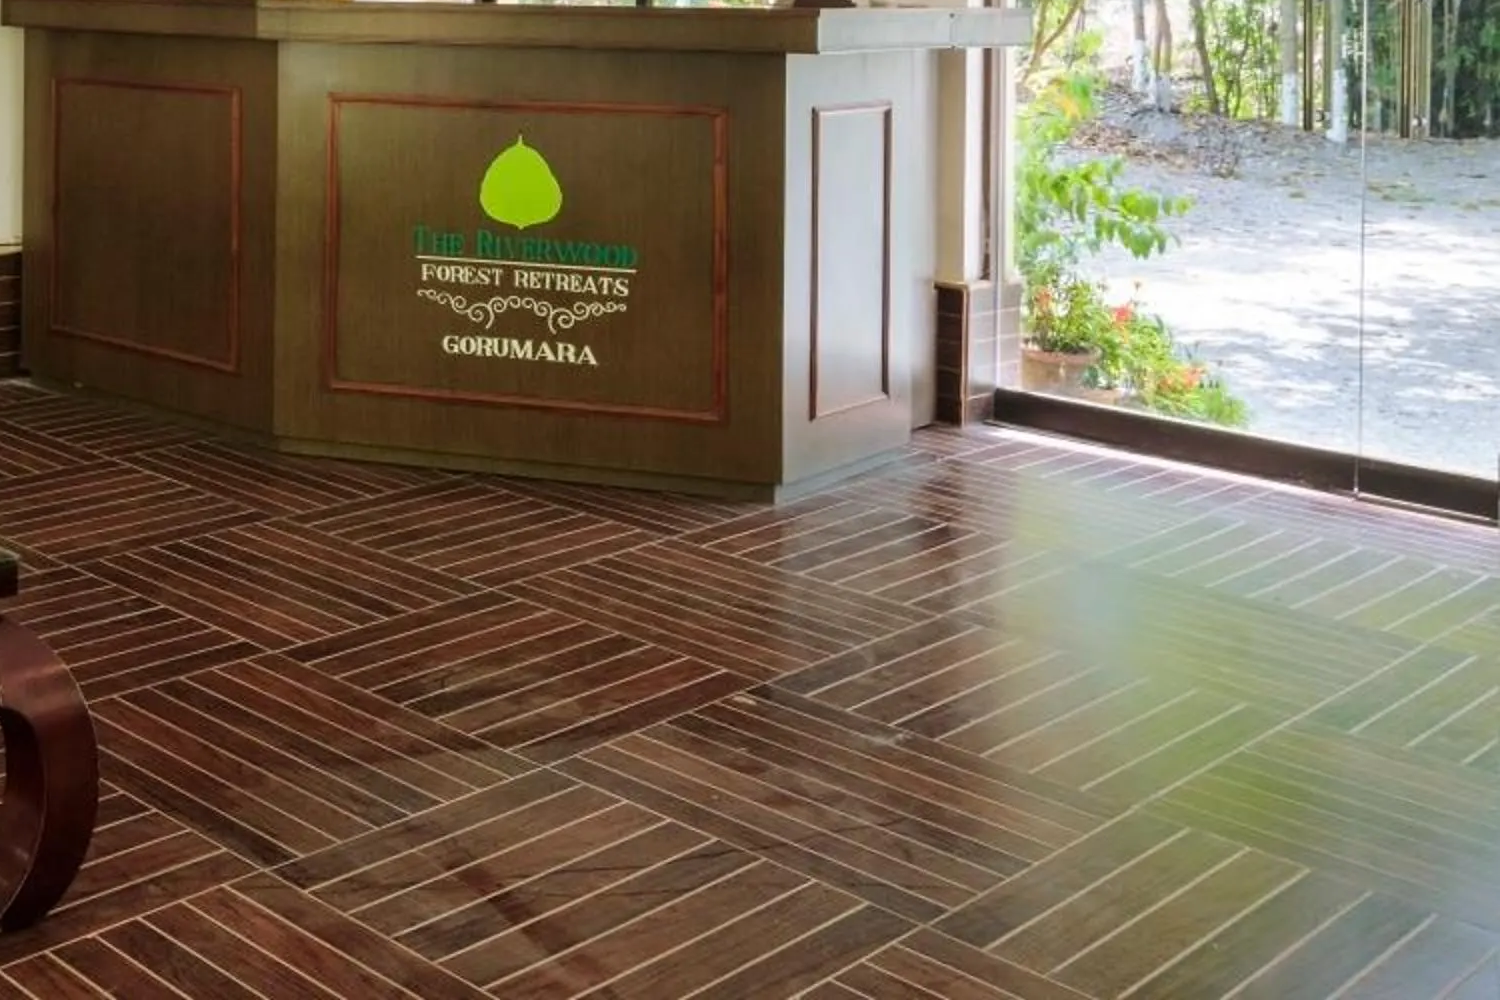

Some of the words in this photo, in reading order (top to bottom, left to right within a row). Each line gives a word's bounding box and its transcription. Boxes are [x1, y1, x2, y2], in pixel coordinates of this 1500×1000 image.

[421, 263, 503, 286] FOREST
[514, 269, 629, 297] RETREATS
[442, 334, 598, 365] GORUMARA
